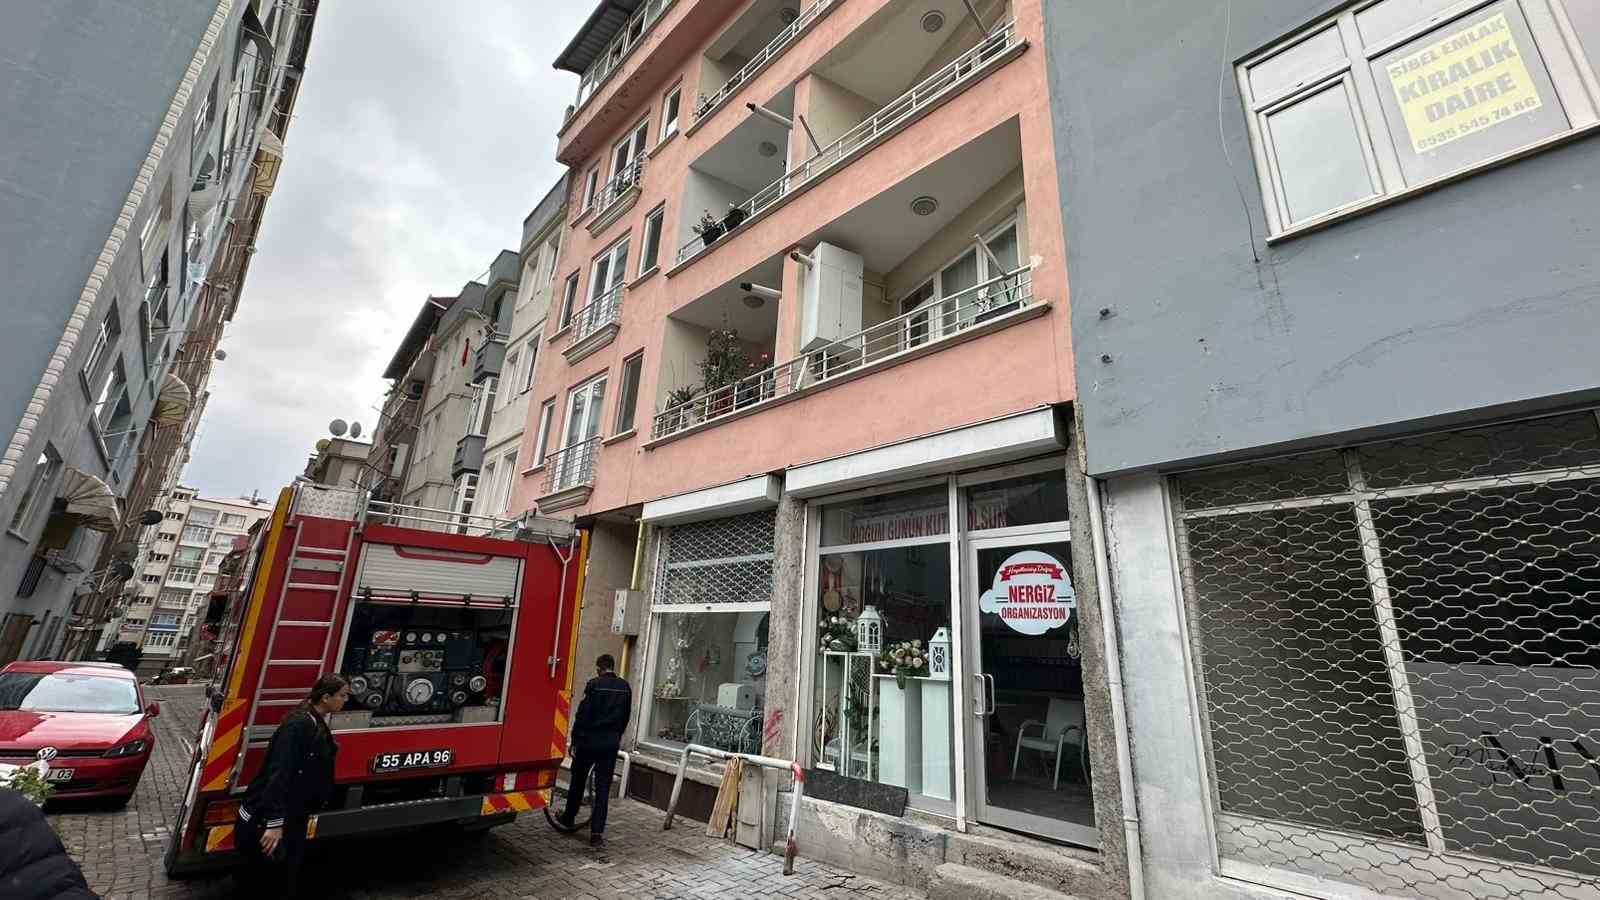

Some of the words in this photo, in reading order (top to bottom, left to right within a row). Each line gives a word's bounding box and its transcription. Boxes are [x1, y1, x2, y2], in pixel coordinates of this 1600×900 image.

[1441, 17, 1506, 55] EMLAK
[381, 754, 400, 768] 55
[403, 752, 430, 766] APA
[433, 750, 450, 763] 96
[57, 769, 73, 779] 03
